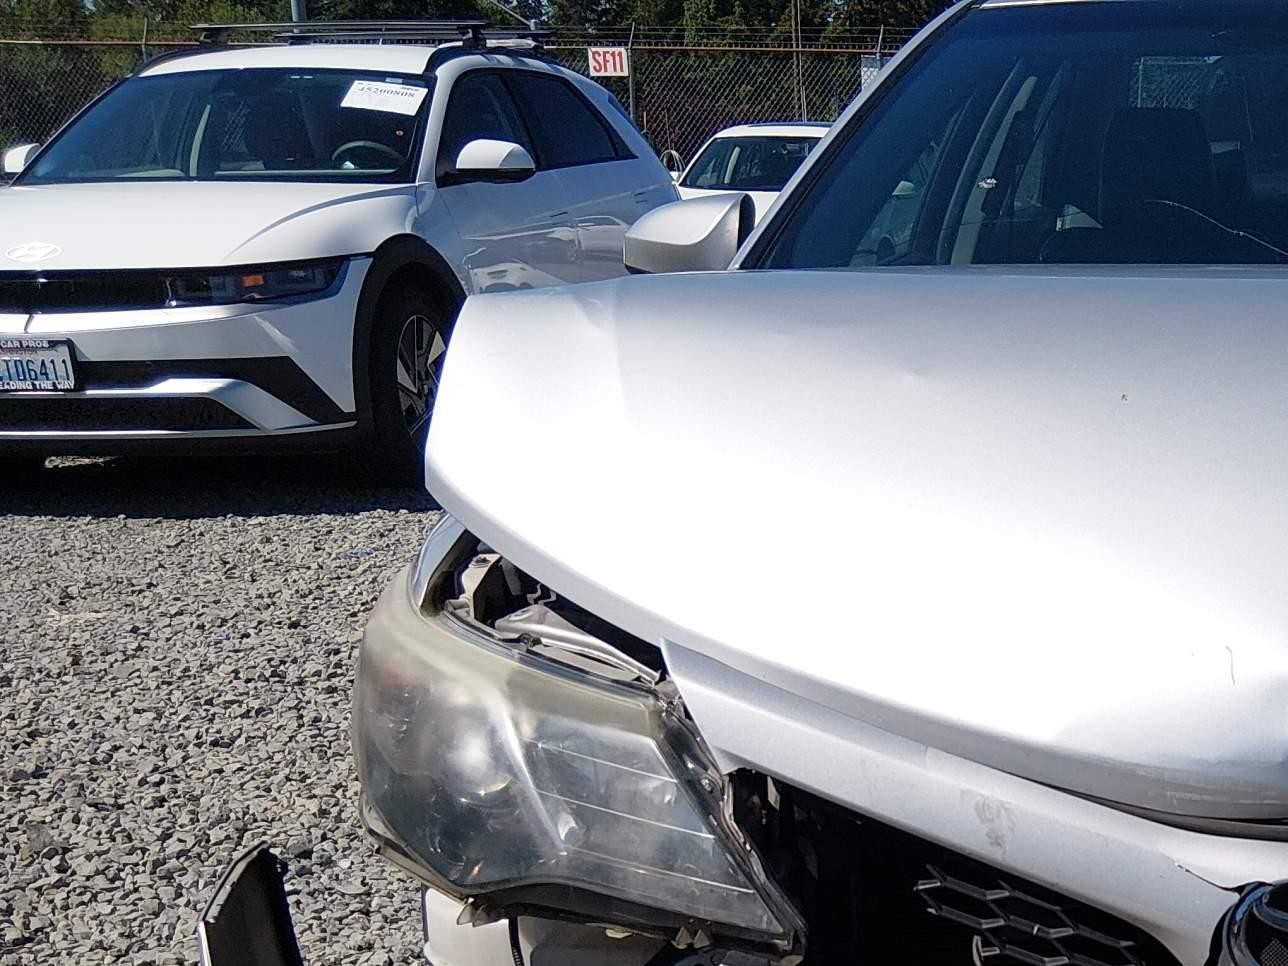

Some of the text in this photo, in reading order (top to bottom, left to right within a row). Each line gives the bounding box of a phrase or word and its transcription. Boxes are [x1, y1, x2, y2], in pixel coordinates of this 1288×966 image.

[591, 51, 624, 72] SF11
[0, 340, 49, 348] CAR PROS
[0, 358, 72, 381] TD6411
[34, 381, 54, 390] THE
[56, 381, 75, 390] WAY
